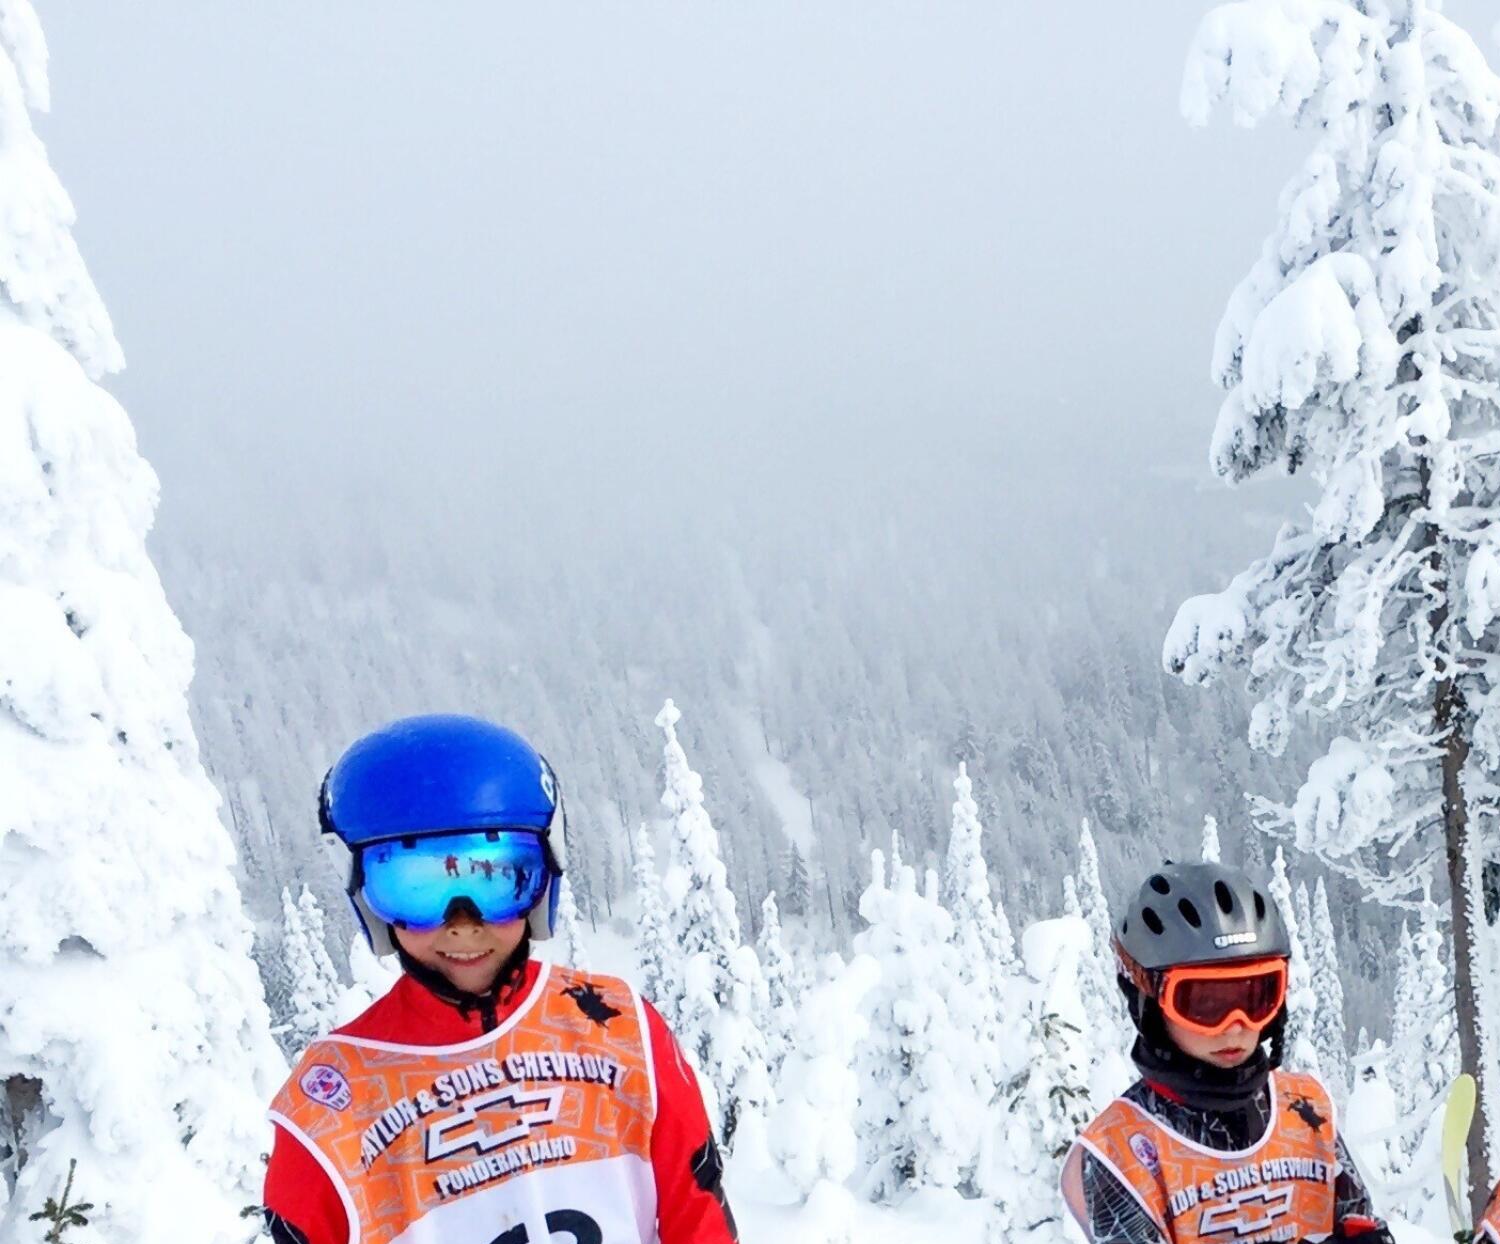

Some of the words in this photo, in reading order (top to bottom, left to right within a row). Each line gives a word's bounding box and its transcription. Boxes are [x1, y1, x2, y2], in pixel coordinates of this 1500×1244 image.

[416, 1089, 438, 1112] &
[434, 1057, 505, 1101] SONS
[1201, 1183, 1215, 1198] &
[1213, 1165, 1262, 1195] SONS
